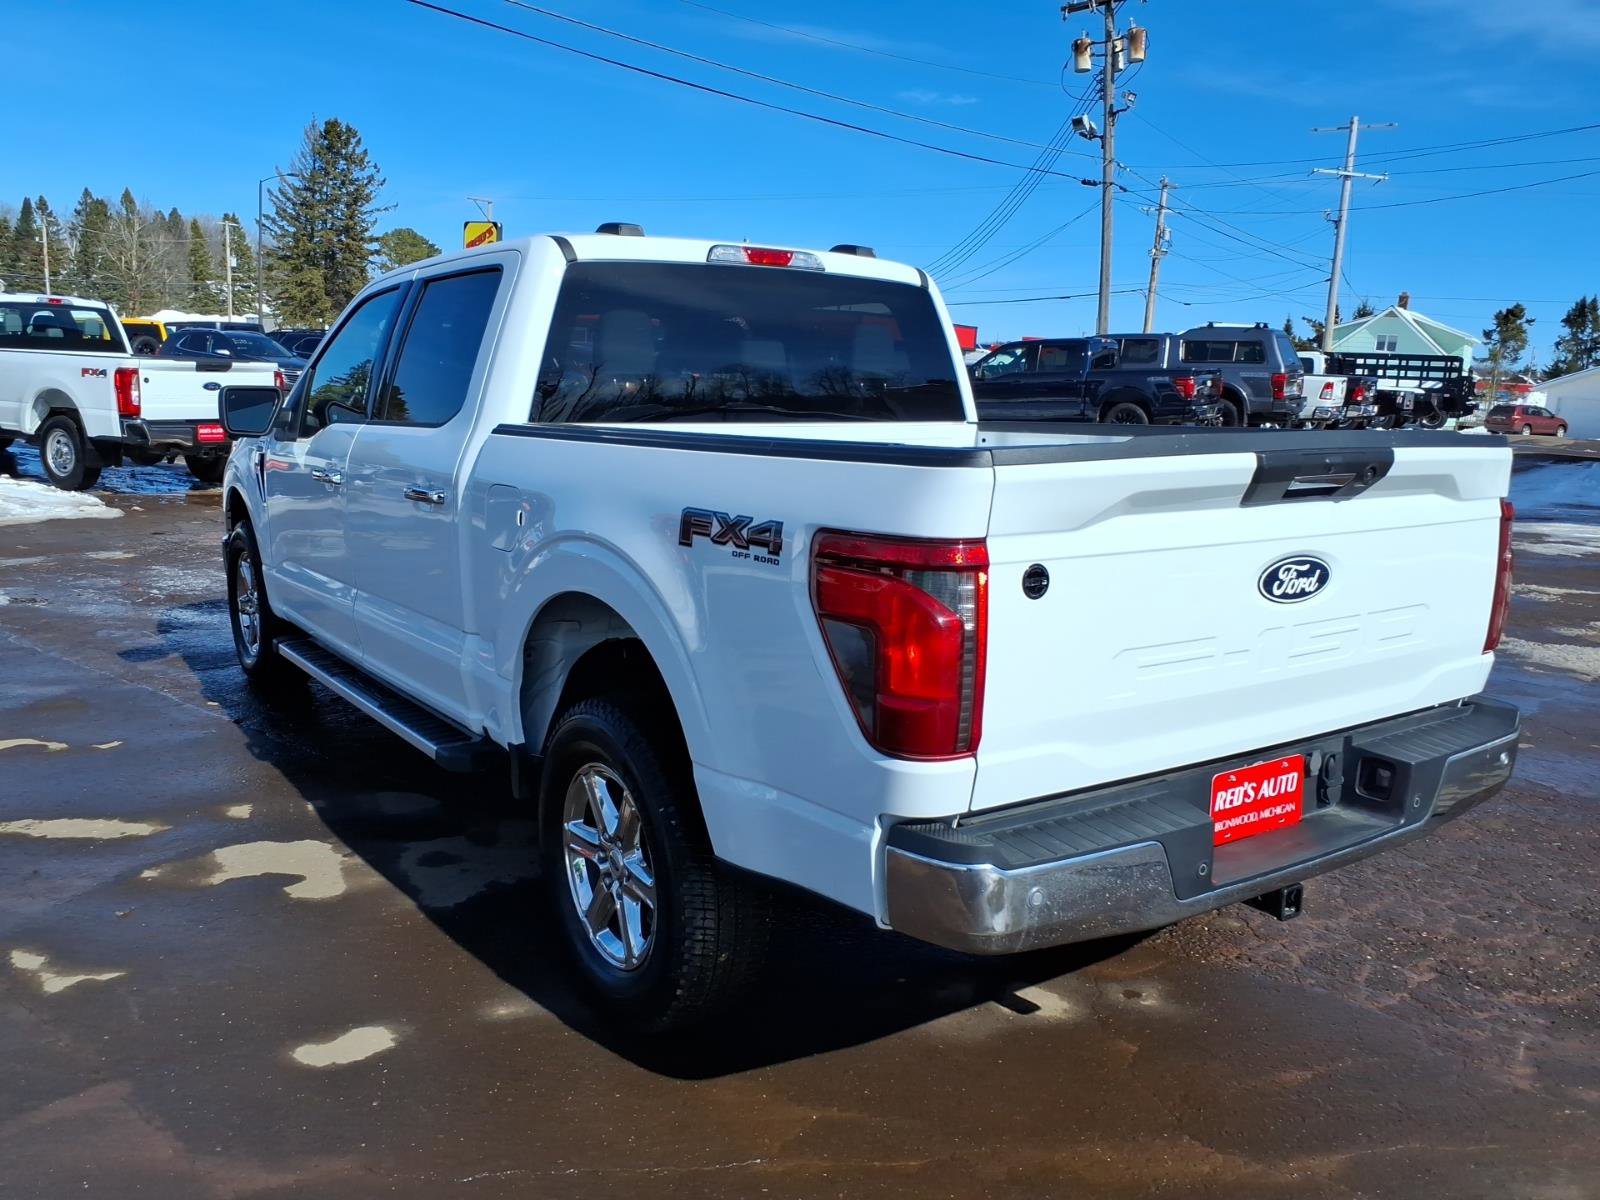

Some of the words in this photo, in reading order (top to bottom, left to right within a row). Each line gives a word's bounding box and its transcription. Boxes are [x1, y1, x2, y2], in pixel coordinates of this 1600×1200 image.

[679, 506, 784, 556] FX4
[731, 550, 751, 560] OFF
[753, 554, 780, 566] ROAD
[1272, 563, 1321, 596] Ford
[1214, 782, 1257, 812] RED'S
[1257, 772, 1298, 800] AUTO
[1260, 802, 1296, 819] MICHIGAN
